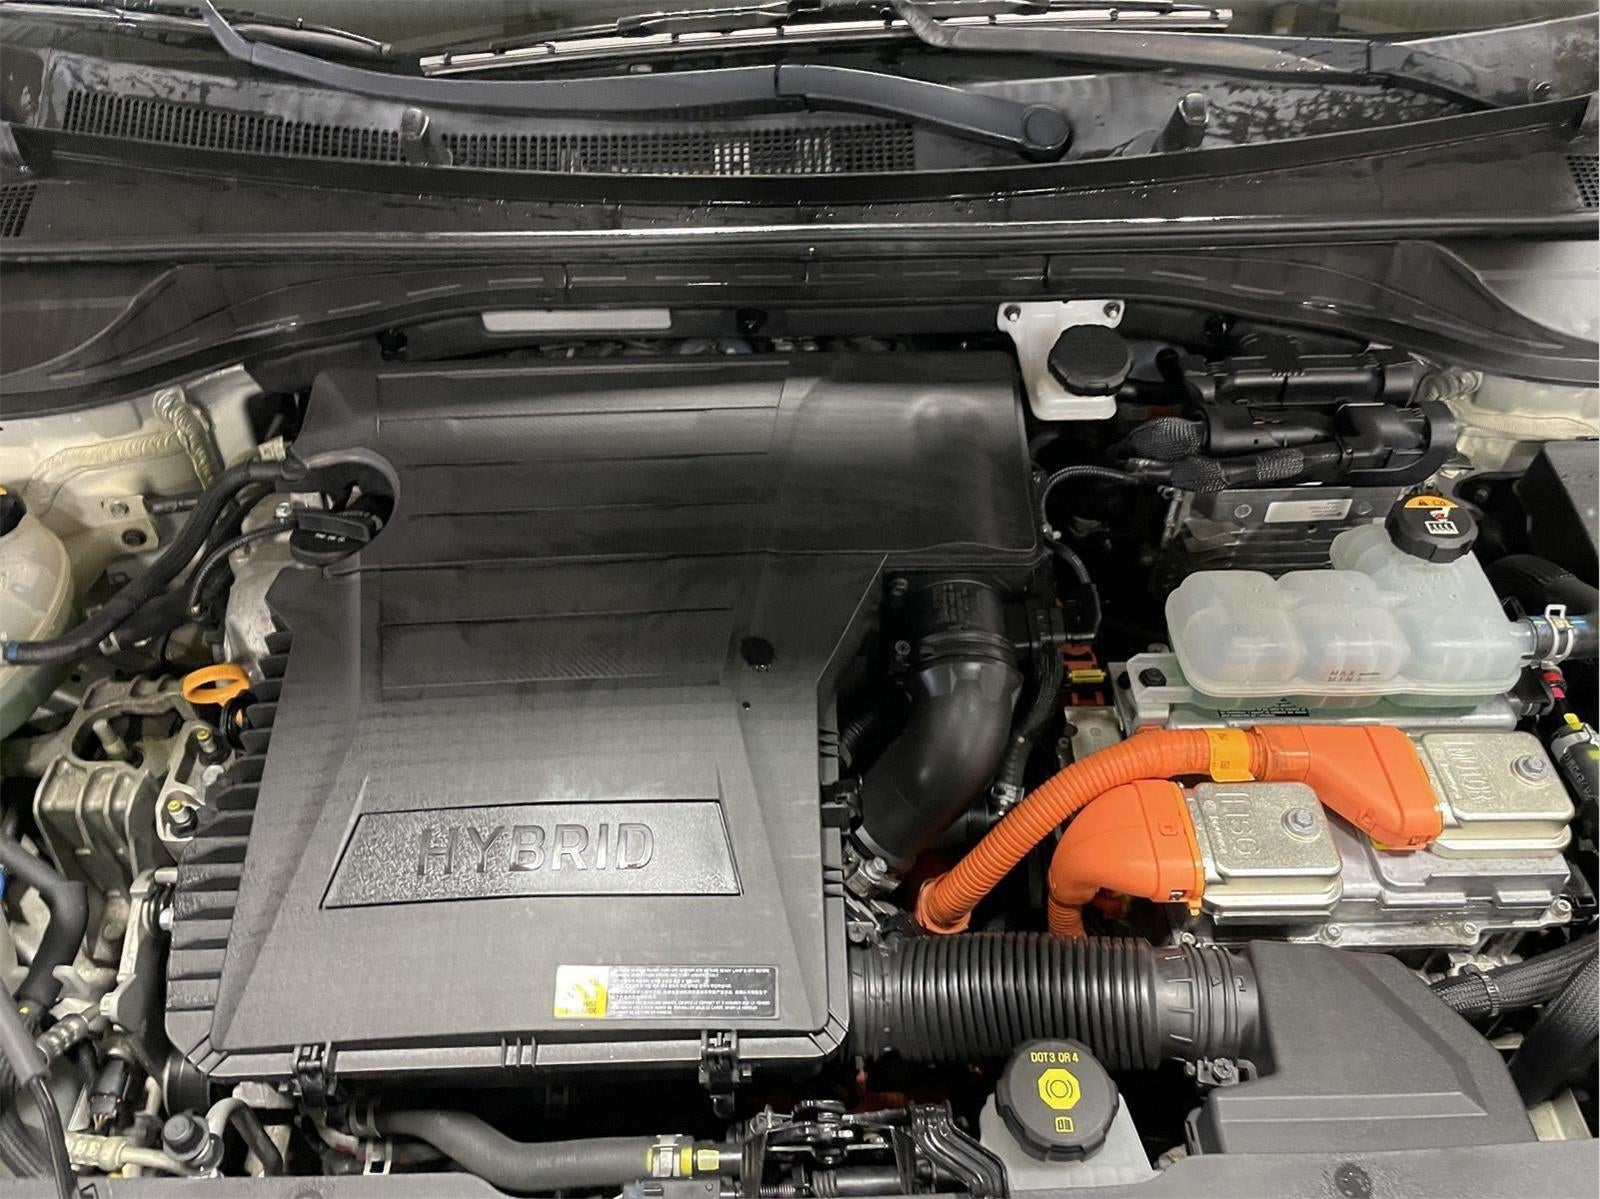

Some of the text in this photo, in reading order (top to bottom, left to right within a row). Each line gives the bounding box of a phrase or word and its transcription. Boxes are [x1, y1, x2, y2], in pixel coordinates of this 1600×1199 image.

[416, 822, 655, 875] HYBRID
[1058, 1052, 1071, 1063] OR
[1072, 1052, 1079, 1062] 4
